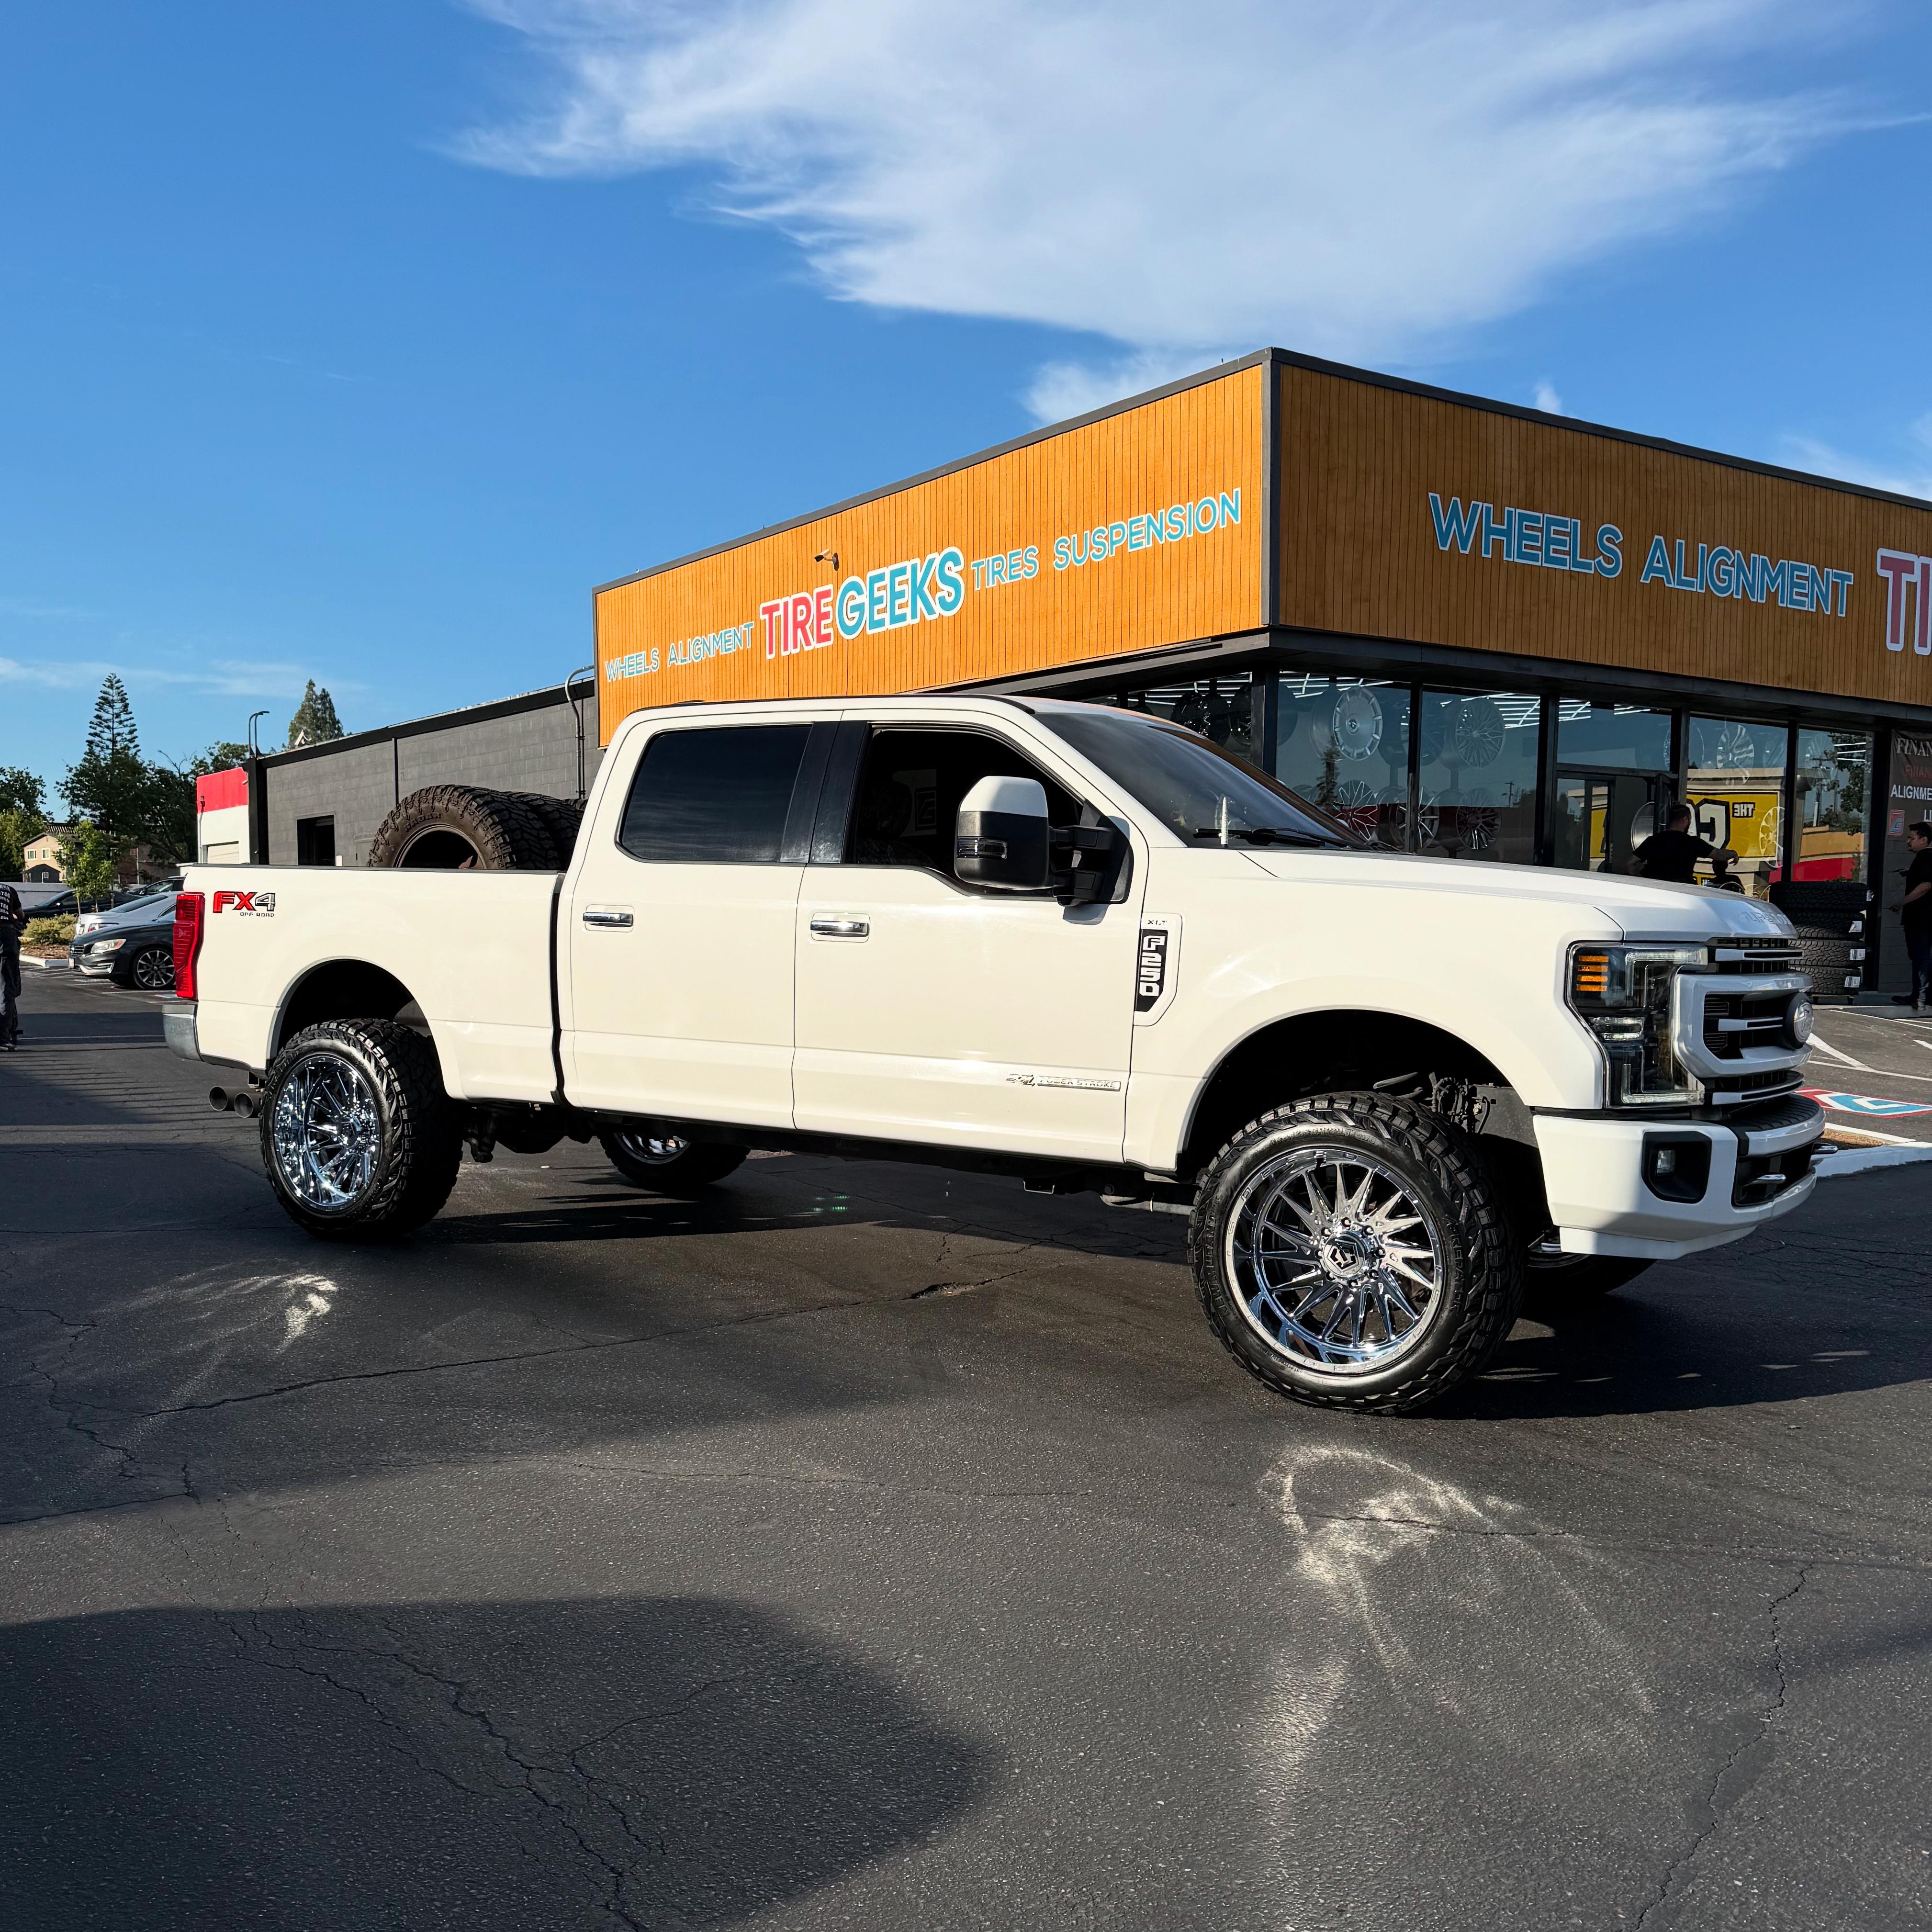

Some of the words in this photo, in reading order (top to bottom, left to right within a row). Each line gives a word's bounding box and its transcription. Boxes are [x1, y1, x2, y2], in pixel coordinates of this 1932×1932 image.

[605, 647, 660, 682] WHEELS
[667, 621, 754, 667] ALIGNMENT
[971, 545, 1038, 590] TIRES
[1053, 487, 1241, 571] SUSPENSION
[1429, 492, 1623, 578] WHEELS
[1640, 535, 1853, 617] ALIGNMENT
[213, 890, 276, 913] FX4
[1077, 1079, 1117, 1089] STROKE
